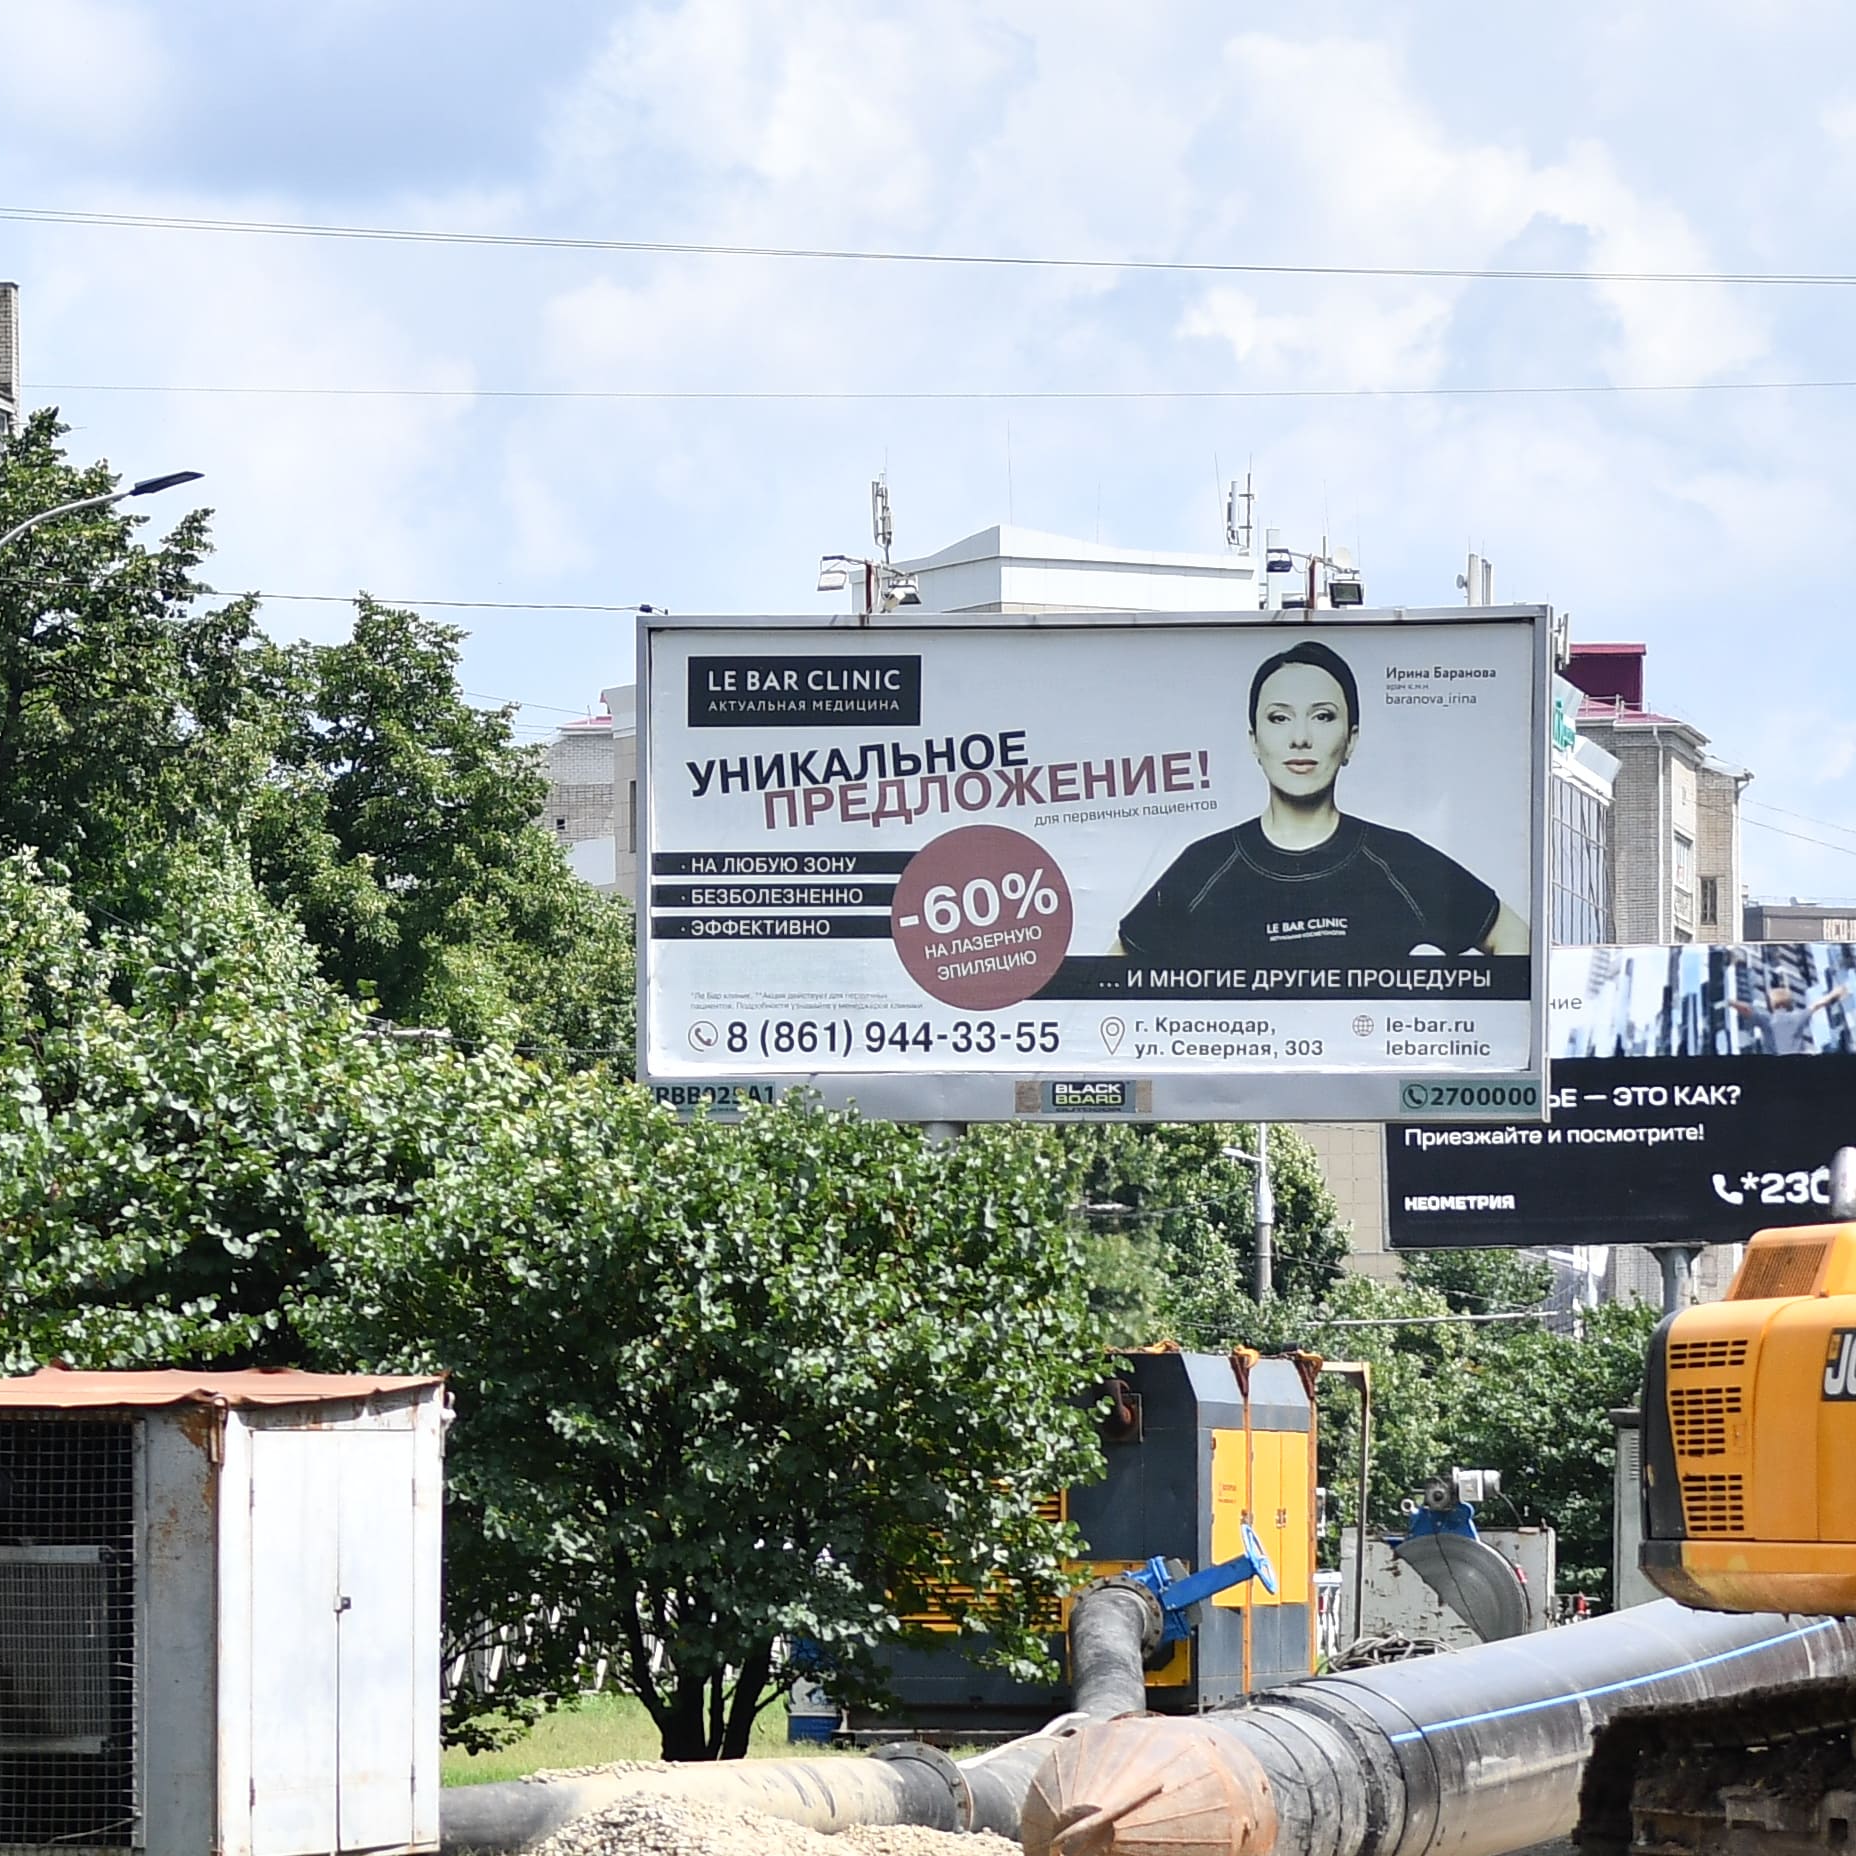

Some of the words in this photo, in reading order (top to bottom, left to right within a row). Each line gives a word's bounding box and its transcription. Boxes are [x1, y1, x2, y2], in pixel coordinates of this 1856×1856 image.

[708, 670, 737, 692] LE
[747, 670, 799, 691] BAR
[807, 669, 901, 691] CLINIC
[1386, 667, 1430, 680] Ирина
[1434, 666, 1497, 681] Баранова
[708, 700, 806, 712] АКТУАЛЬНАЯ
[813, 700, 900, 713] МЕДИЦИНА
[1386, 693, 1477, 707] baranova_irina
[686, 729, 1029, 798] УНИКАЛЬНОЕ
[764, 750, 1210, 829] ПРЕДЛОЖЕНИЕ!
[1034, 813, 1059, 828] для
[1063, 807, 1140, 824] первичных
[1143, 799, 1218, 816] пациентов
[692, 858, 718, 873] НА
[721, 858, 798, 874] ЛЮБУЮ
[804, 857, 856, 873] ЗОНУ
[691, 888, 863, 905] БЕЗБОЛЕЗНЕННО
[899, 868, 1059, 935] -60%
[691, 919, 830, 936] ЭФФЕКТИВНО
[1266, 922, 1279, 934] LE
[1282, 920, 1304, 933] BAR
[1307, 917, 1348, 930] CLINIC
[924, 944, 949, 960] НА
[950, 925, 1042, 956] ЛАЗЕРНУЮ
[937, 949, 1037, 982] ЭПИЛЯЦИЮ
[1128, 970, 1143, 987] И
[1150, 970, 1246, 988] МНОГИЕ
[1252, 970, 1341, 990] ДРУГИЕ
[1347, 970, 1491, 991] ПРОЦЕДУРЫ
[1135, 1022, 1146, 1033] г.
[1155, 1016, 1276, 1036] Краснодар,
[1386, 1017, 1475, 1033] le-bar.ru
[727, 1021, 748, 1053] 8
[760, 1019, 853, 1056] (861)
[865, 1021, 1060, 1053] 944-33-55
[1135, 1043, 1163, 1058] ул.
[1171, 1041, 1278, 1059] Северная,
[1285, 1041, 1323, 1056] 303
[1386, 1041, 1491, 1056] lebarclinic
[1055, 1084, 1121, 1094] BLACK
[1431, 1087, 1537, 1106] 2700000
[1613, 1086, 1668, 1107] ЭТО
[1673, 1085, 1741, 1106] КАК?
[1055, 1095, 1122, 1104] BOARD
[1405, 1126, 1542, 1150] Приезжайте
[1548, 1130, 1562, 1144] и
[1567, 1124, 1704, 1146] посмотрите!
[1405, 1195, 1515, 1212] НЕОМЕТРИЯ
